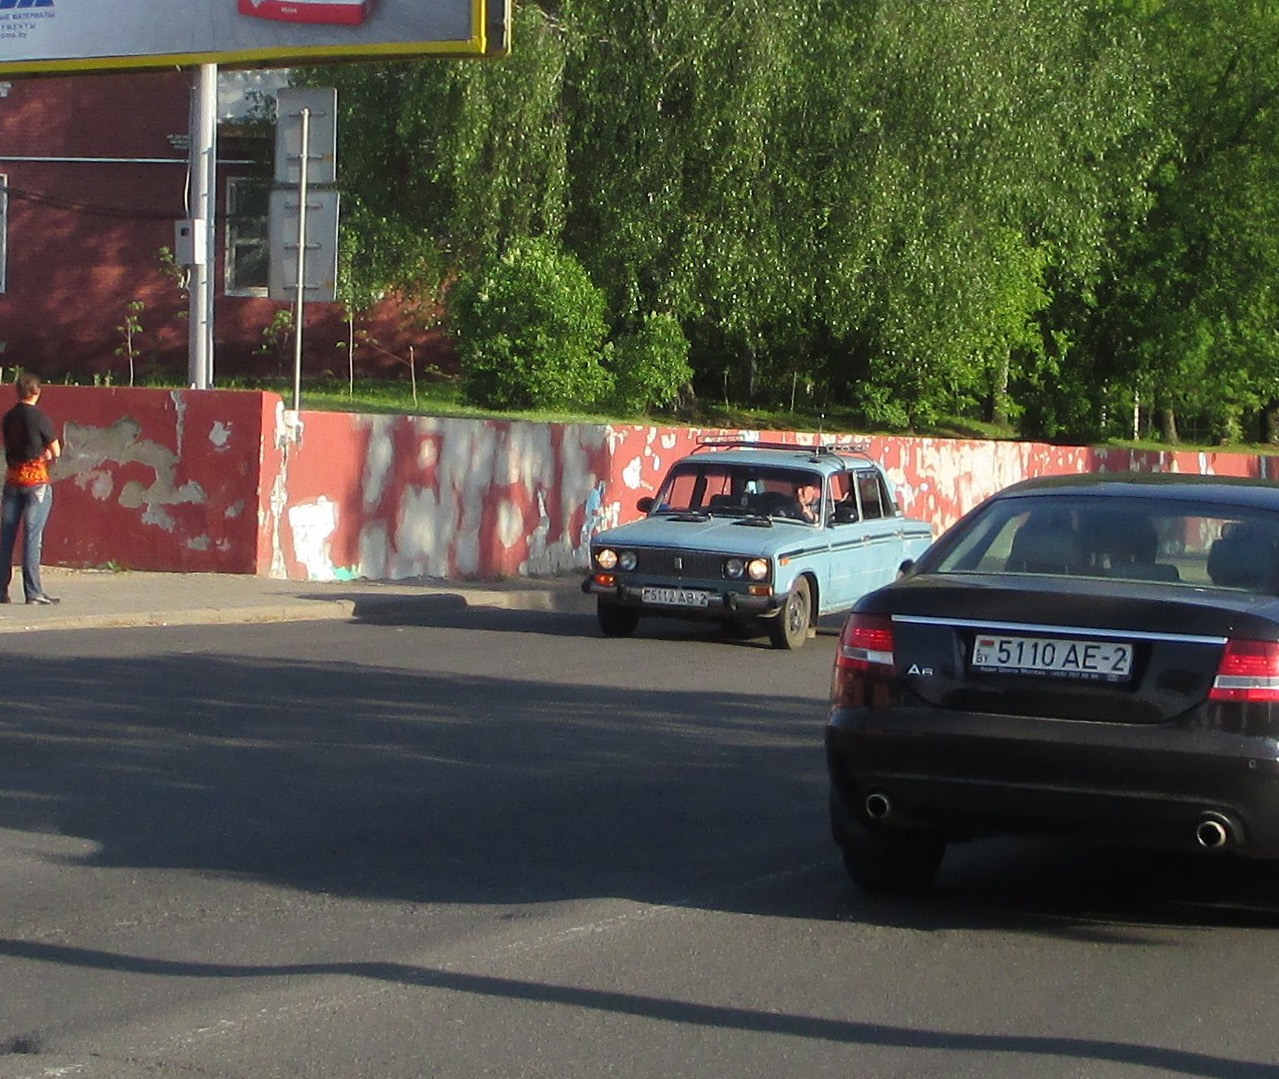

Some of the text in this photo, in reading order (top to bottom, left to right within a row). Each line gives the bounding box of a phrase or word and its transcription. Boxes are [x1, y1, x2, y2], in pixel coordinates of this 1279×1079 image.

[976, 653, 990, 663] BY
[997, 639, 1128, 672] 5110 AE-2
